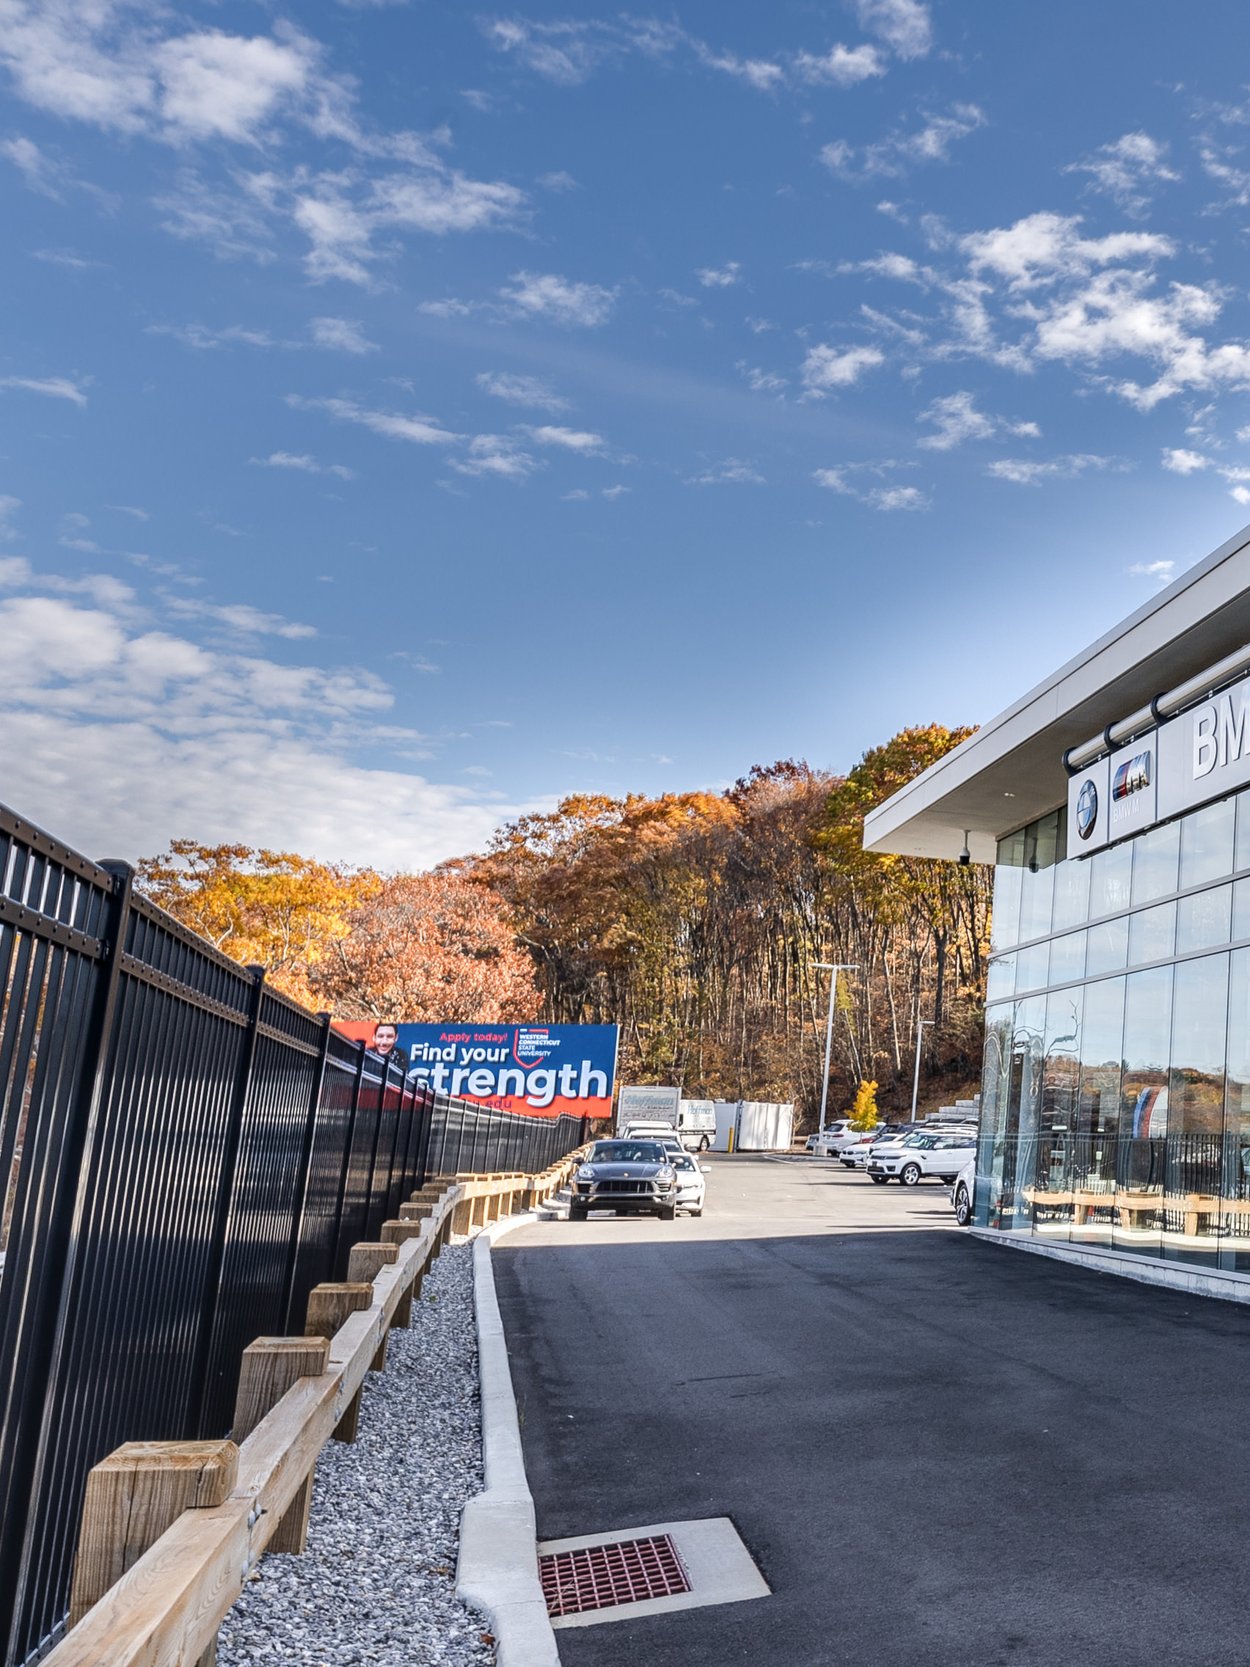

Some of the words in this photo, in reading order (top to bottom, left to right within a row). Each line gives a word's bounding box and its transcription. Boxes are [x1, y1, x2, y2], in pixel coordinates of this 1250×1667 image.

[439, 1032, 471, 1043] Apply
[473, 1032, 508, 1043] today!
[410, 1042, 456, 1062] Find
[459, 1047, 510, 1065] your
[408, 1060, 607, 1107] strength
